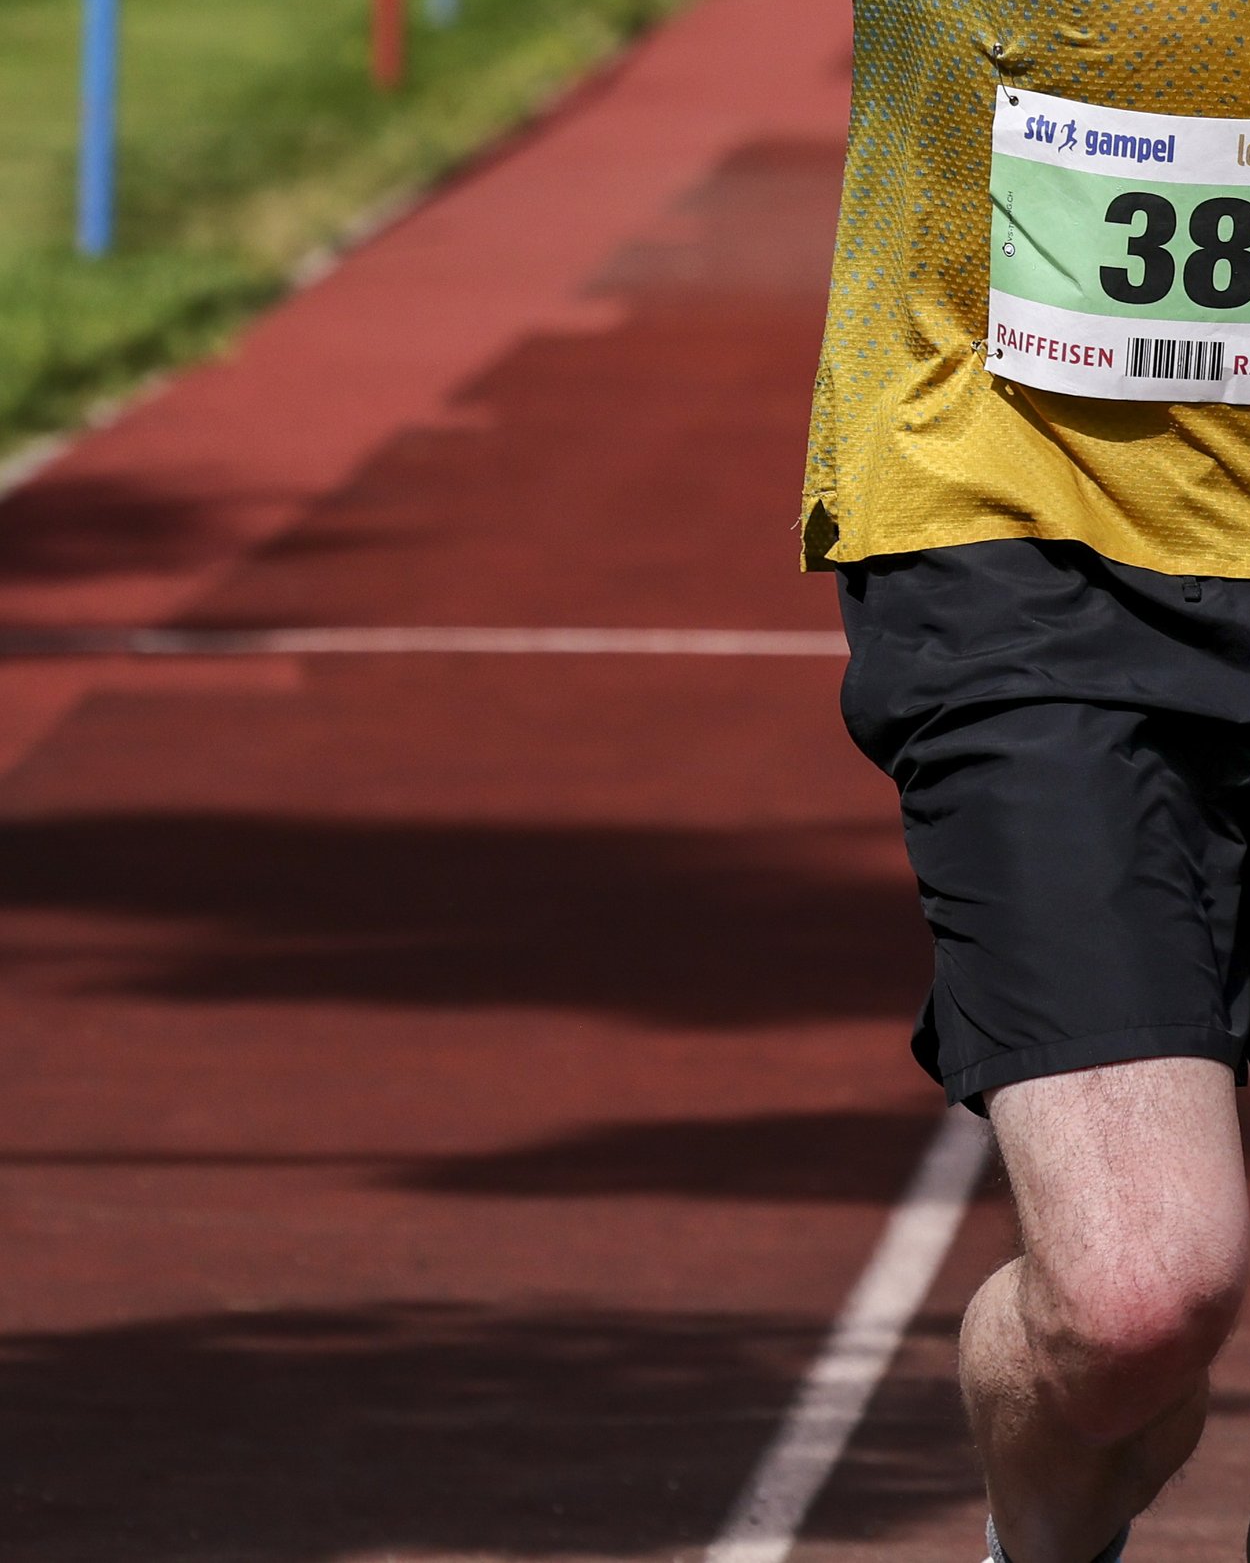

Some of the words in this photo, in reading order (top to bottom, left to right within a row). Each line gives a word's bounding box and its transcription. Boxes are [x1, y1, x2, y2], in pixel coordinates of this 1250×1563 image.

[1024, 115, 1056, 144] stv
[1085, 130, 1175, 163] gampel
[997, 323, 1114, 368] RAIFFEISEN
